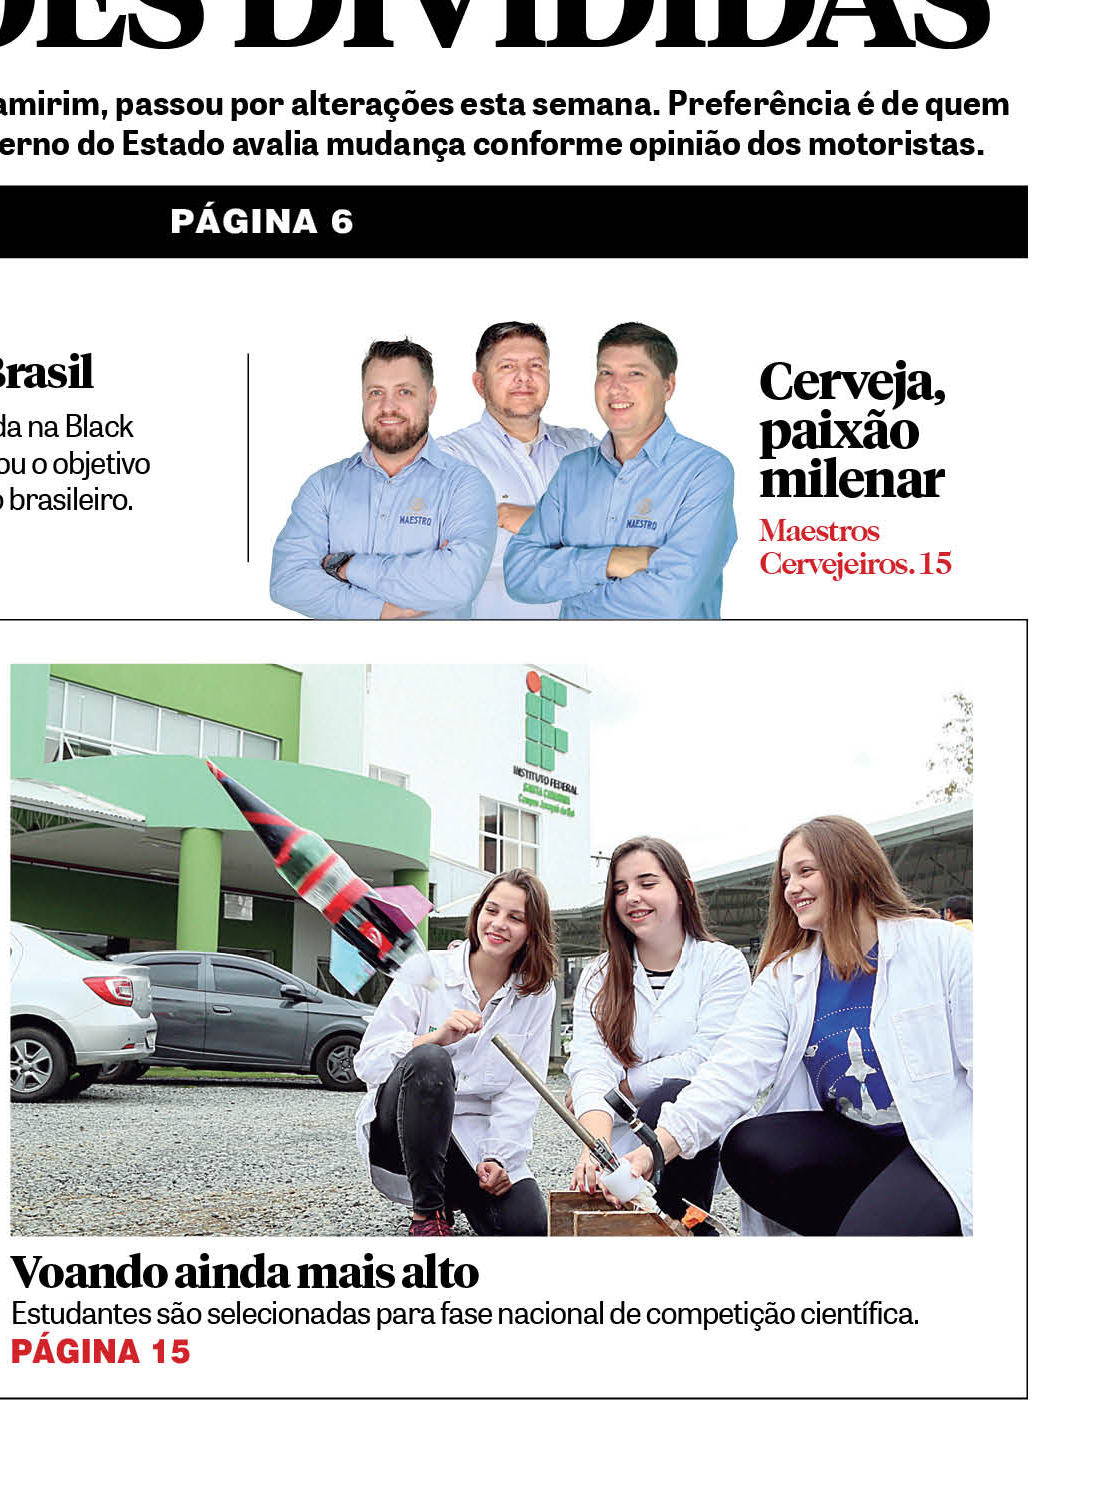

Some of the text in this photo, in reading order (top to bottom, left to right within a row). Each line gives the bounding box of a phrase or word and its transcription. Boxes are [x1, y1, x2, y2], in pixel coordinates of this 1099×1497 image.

[115, 97, 223, 122] passou
[230, 97, 285, 122] por
[291, 89, 455, 123] alterações
[460, 92, 527, 117] esta
[532, 97, 661, 117] semana.
[668, 89, 852, 117] Preferência
[857, 89, 875, 116] é
[881, 89, 919, 116] de
[925, 97, 1010, 122] quem
[77, 129, 115, 156] do
[122, 129, 225, 157] Estado
[232, 129, 320, 157] avalia
[326, 129, 467, 163] mudança
[473, 129, 623, 156] conforme
[629, 129, 741, 162] opinião
[747, 129, 802, 156] dos
[809, 129, 985, 157] motoristas.
[171, 200, 353, 235] PÁGINA 6
[759, 359, 946, 410] Cerveja,
[28, 420, 60, 438] na
[66, 413, 135, 438] Black
[758, 408, 920, 460] paixão
[31, 457, 48, 475] o
[52, 450, 151, 481] objetivo
[760, 456, 945, 498] milenar
[9, 486, 133, 511] brasileiro.
[399, 515, 432, 527] MAESTRO
[626, 518, 658, 531] MAESTRO
[758, 518, 881, 542] Maestros
[919, 550, 952, 575] 15
[513, 765, 550, 785] INSTITUTO
[9, 1252, 480, 1289] Voando ainda mais alto
[13, 1300, 919, 1332] Estudantes são selecionadas para fase nacional de competição científica.
[11, 1331, 191, 1365] PÁGINA 15
